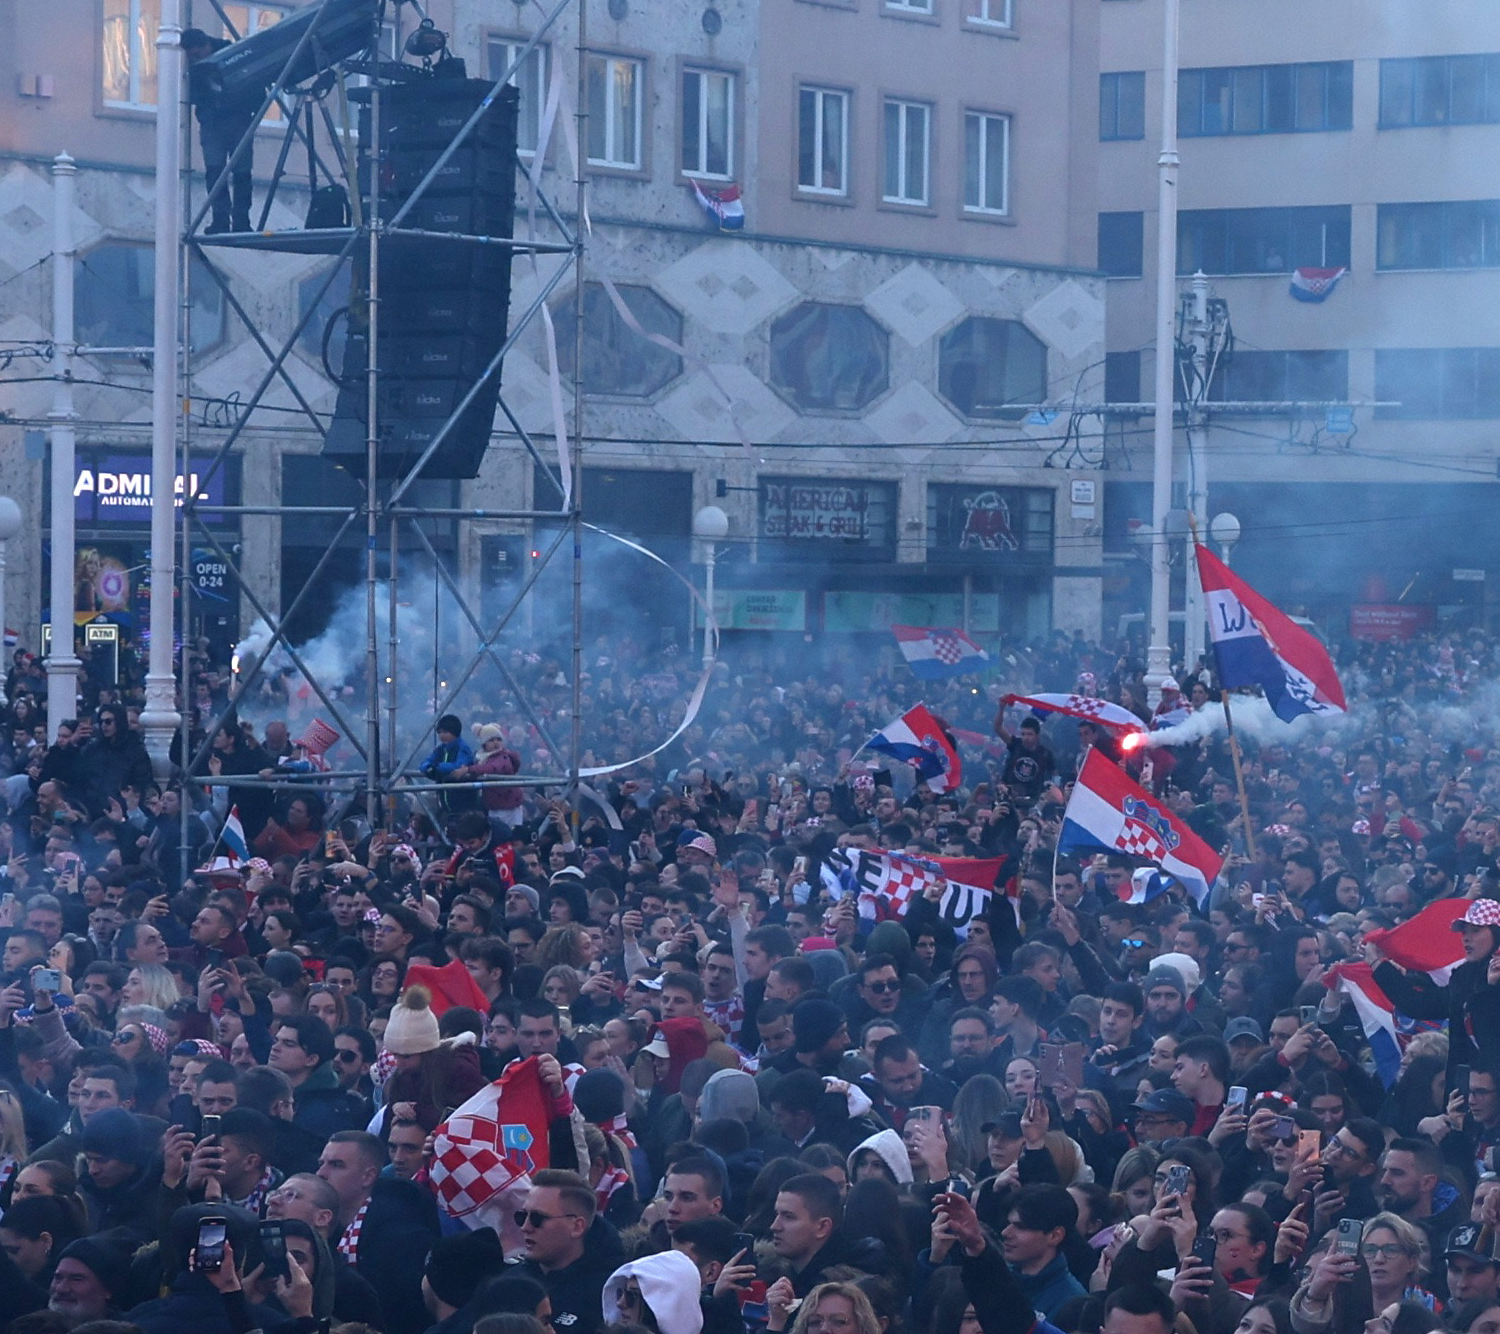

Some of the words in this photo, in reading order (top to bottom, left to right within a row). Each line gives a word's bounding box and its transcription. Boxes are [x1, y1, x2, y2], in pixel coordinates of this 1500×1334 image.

[73, 469, 209, 500] ADMIAL
[196, 563, 227, 575] OPEN
[198, 576, 224, 588] 0-24
[91, 629, 114, 639] ATM
